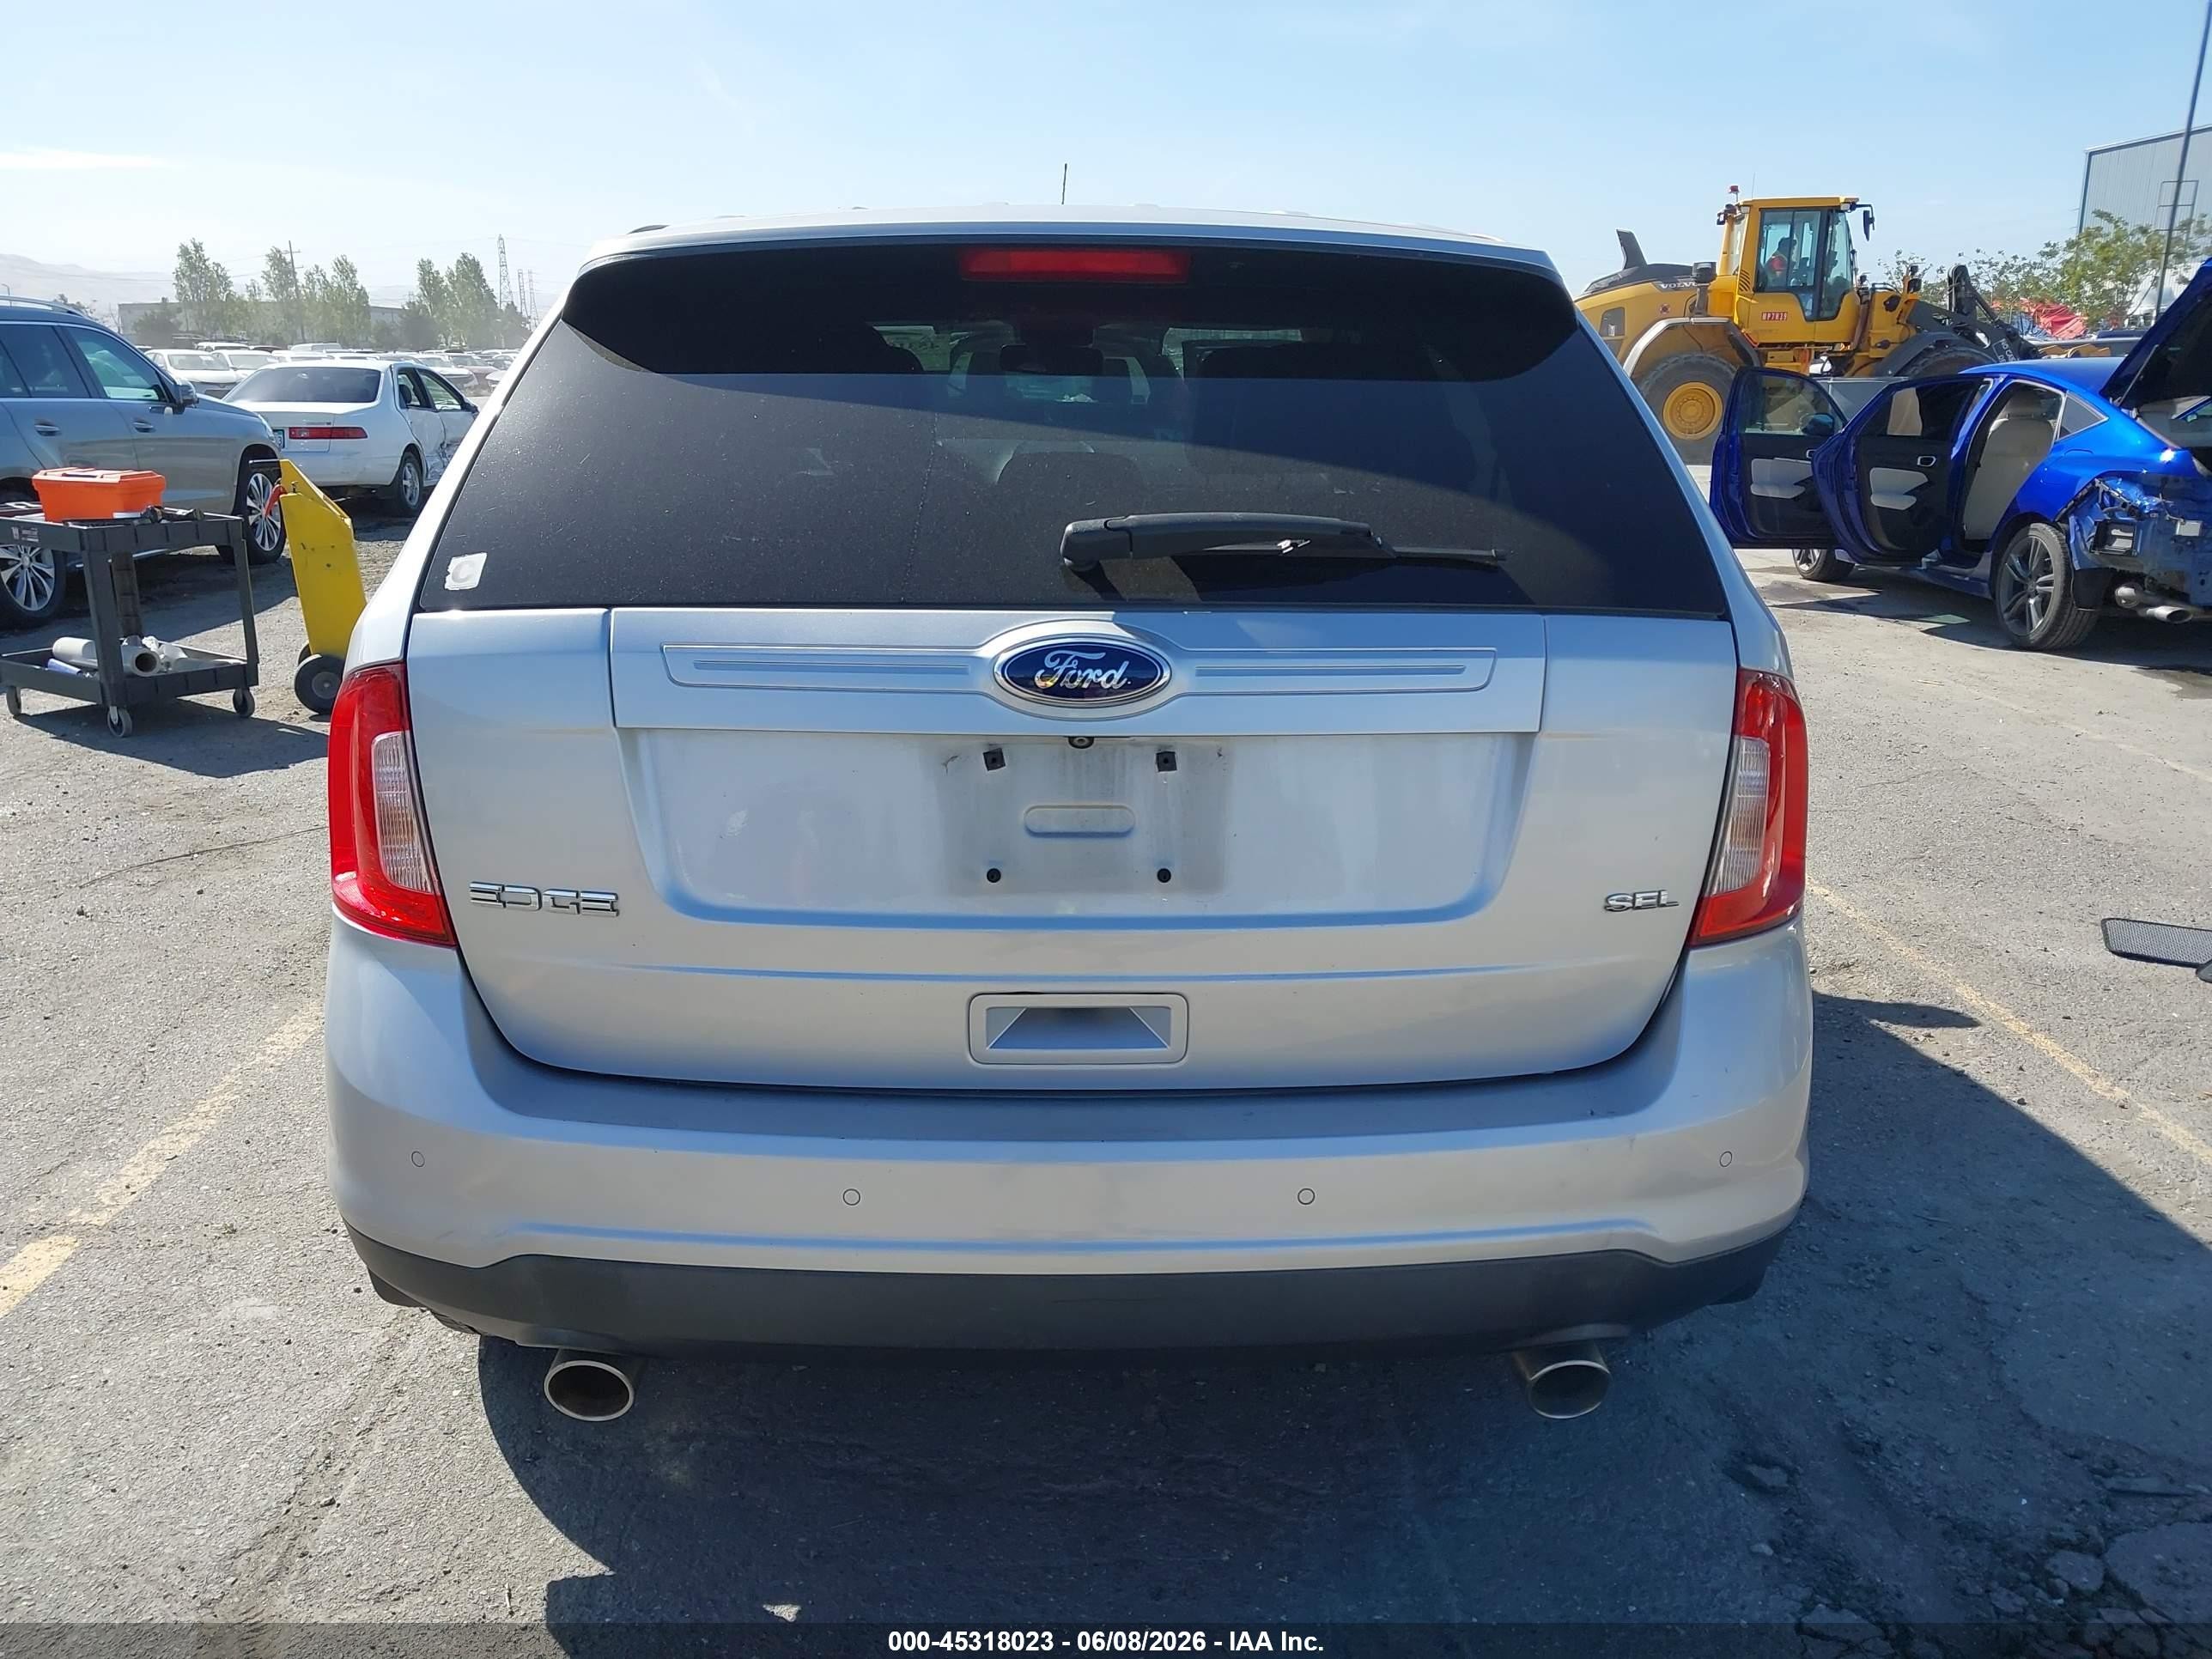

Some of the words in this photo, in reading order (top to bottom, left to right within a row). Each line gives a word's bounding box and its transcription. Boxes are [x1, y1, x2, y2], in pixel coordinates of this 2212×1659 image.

[1034, 649, 1129, 689] Ford
[470, 881, 618, 917] EDGE
[1604, 890, 1679, 912] SEL
